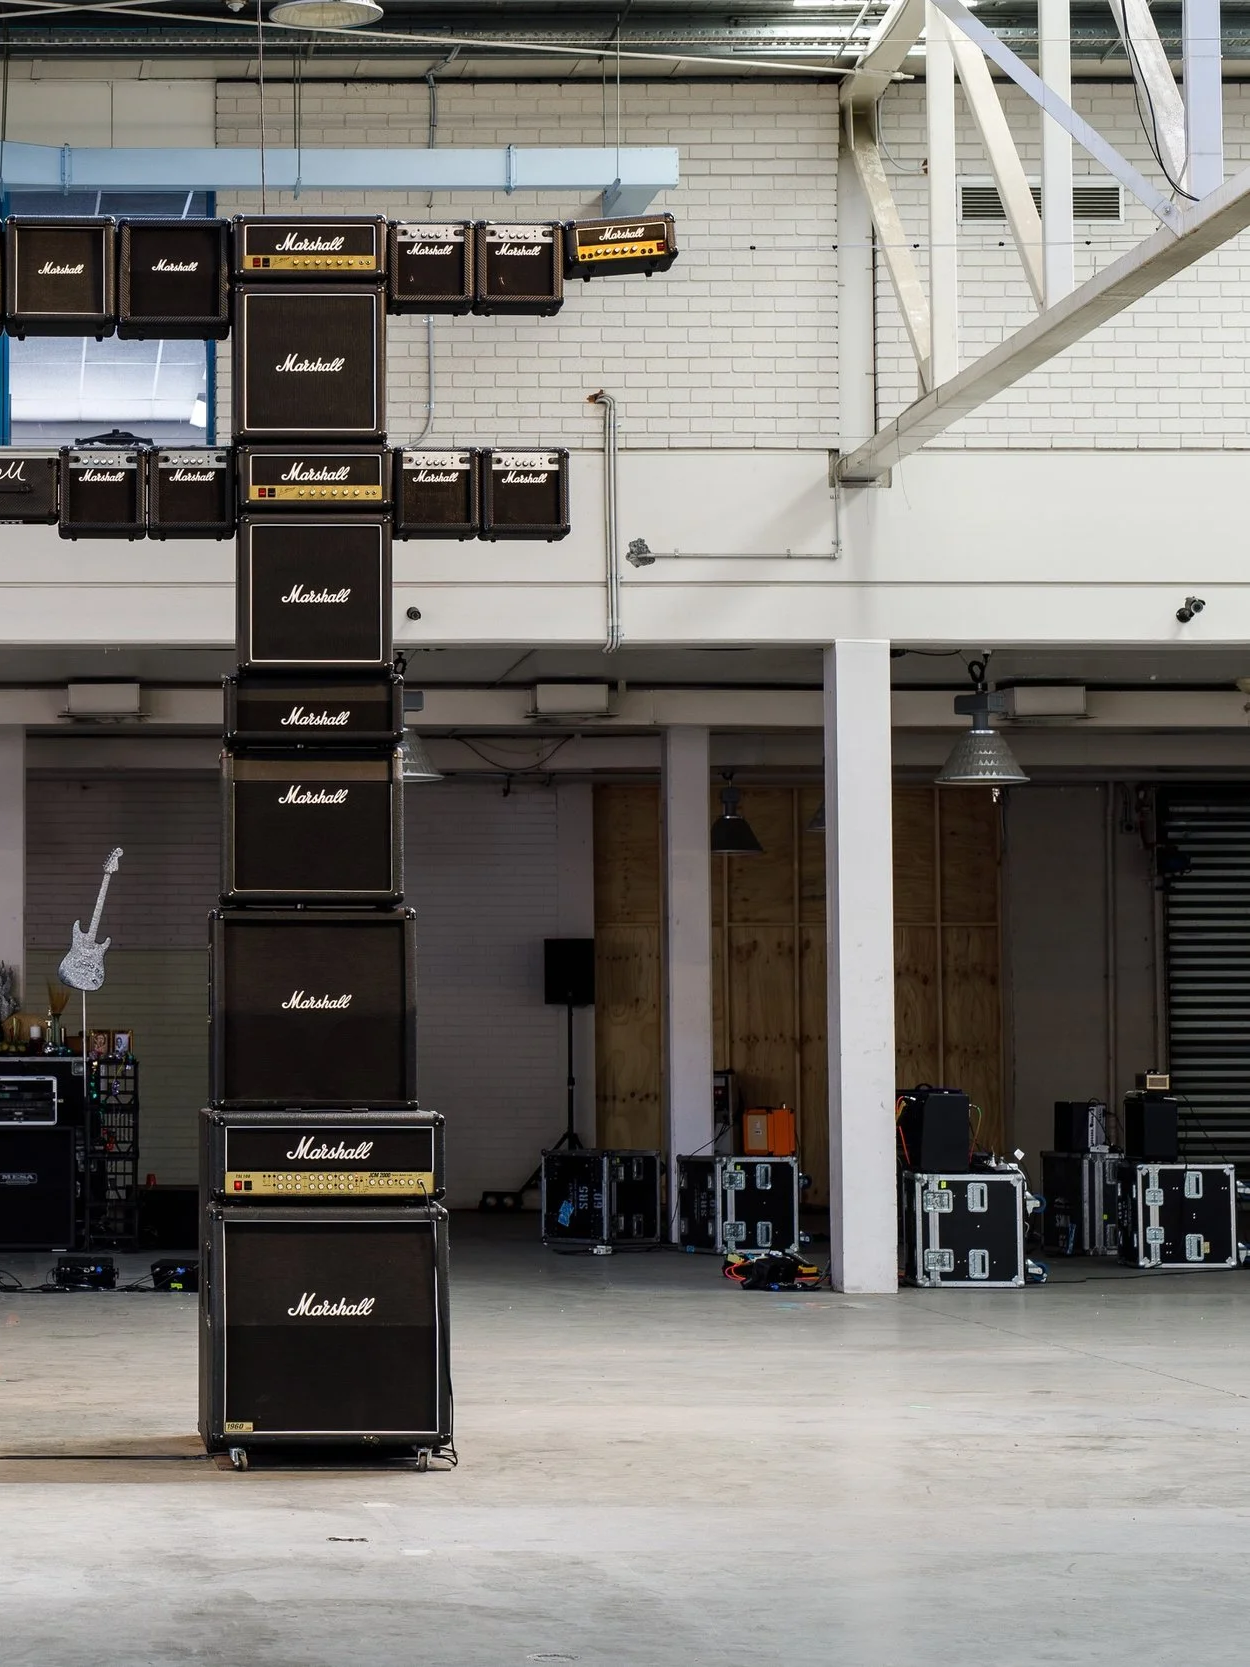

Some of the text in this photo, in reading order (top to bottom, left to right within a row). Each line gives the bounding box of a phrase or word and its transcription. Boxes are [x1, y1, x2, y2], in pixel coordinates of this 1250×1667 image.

[275, 232, 345, 251] Marshall
[598, 227, 645, 241] Marshall
[407, 242, 453, 256] Marshall
[495, 243, 541, 256] Marshall
[37, 262, 85, 275] Marshall
[151, 259, 199, 272] Marshall
[275, 353, 346, 372] Marshall
[78, 468, 125, 482] Marshall
[169, 468, 215, 482] Marshall
[280, 461, 351, 481] Marshall
[412, 470, 459, 483] Marshall
[502, 470, 547, 484] Marshall
[281, 583, 351, 604] Marshall
[280, 706, 351, 726] Marshall
[278, 784, 349, 804] Marshall
[281, 990, 353, 1009] Marshall
[286, 1135, 374, 1160] Marshall
[578, 1185, 589, 1210] SR5
[287, 1292, 376, 1317] Marshall
